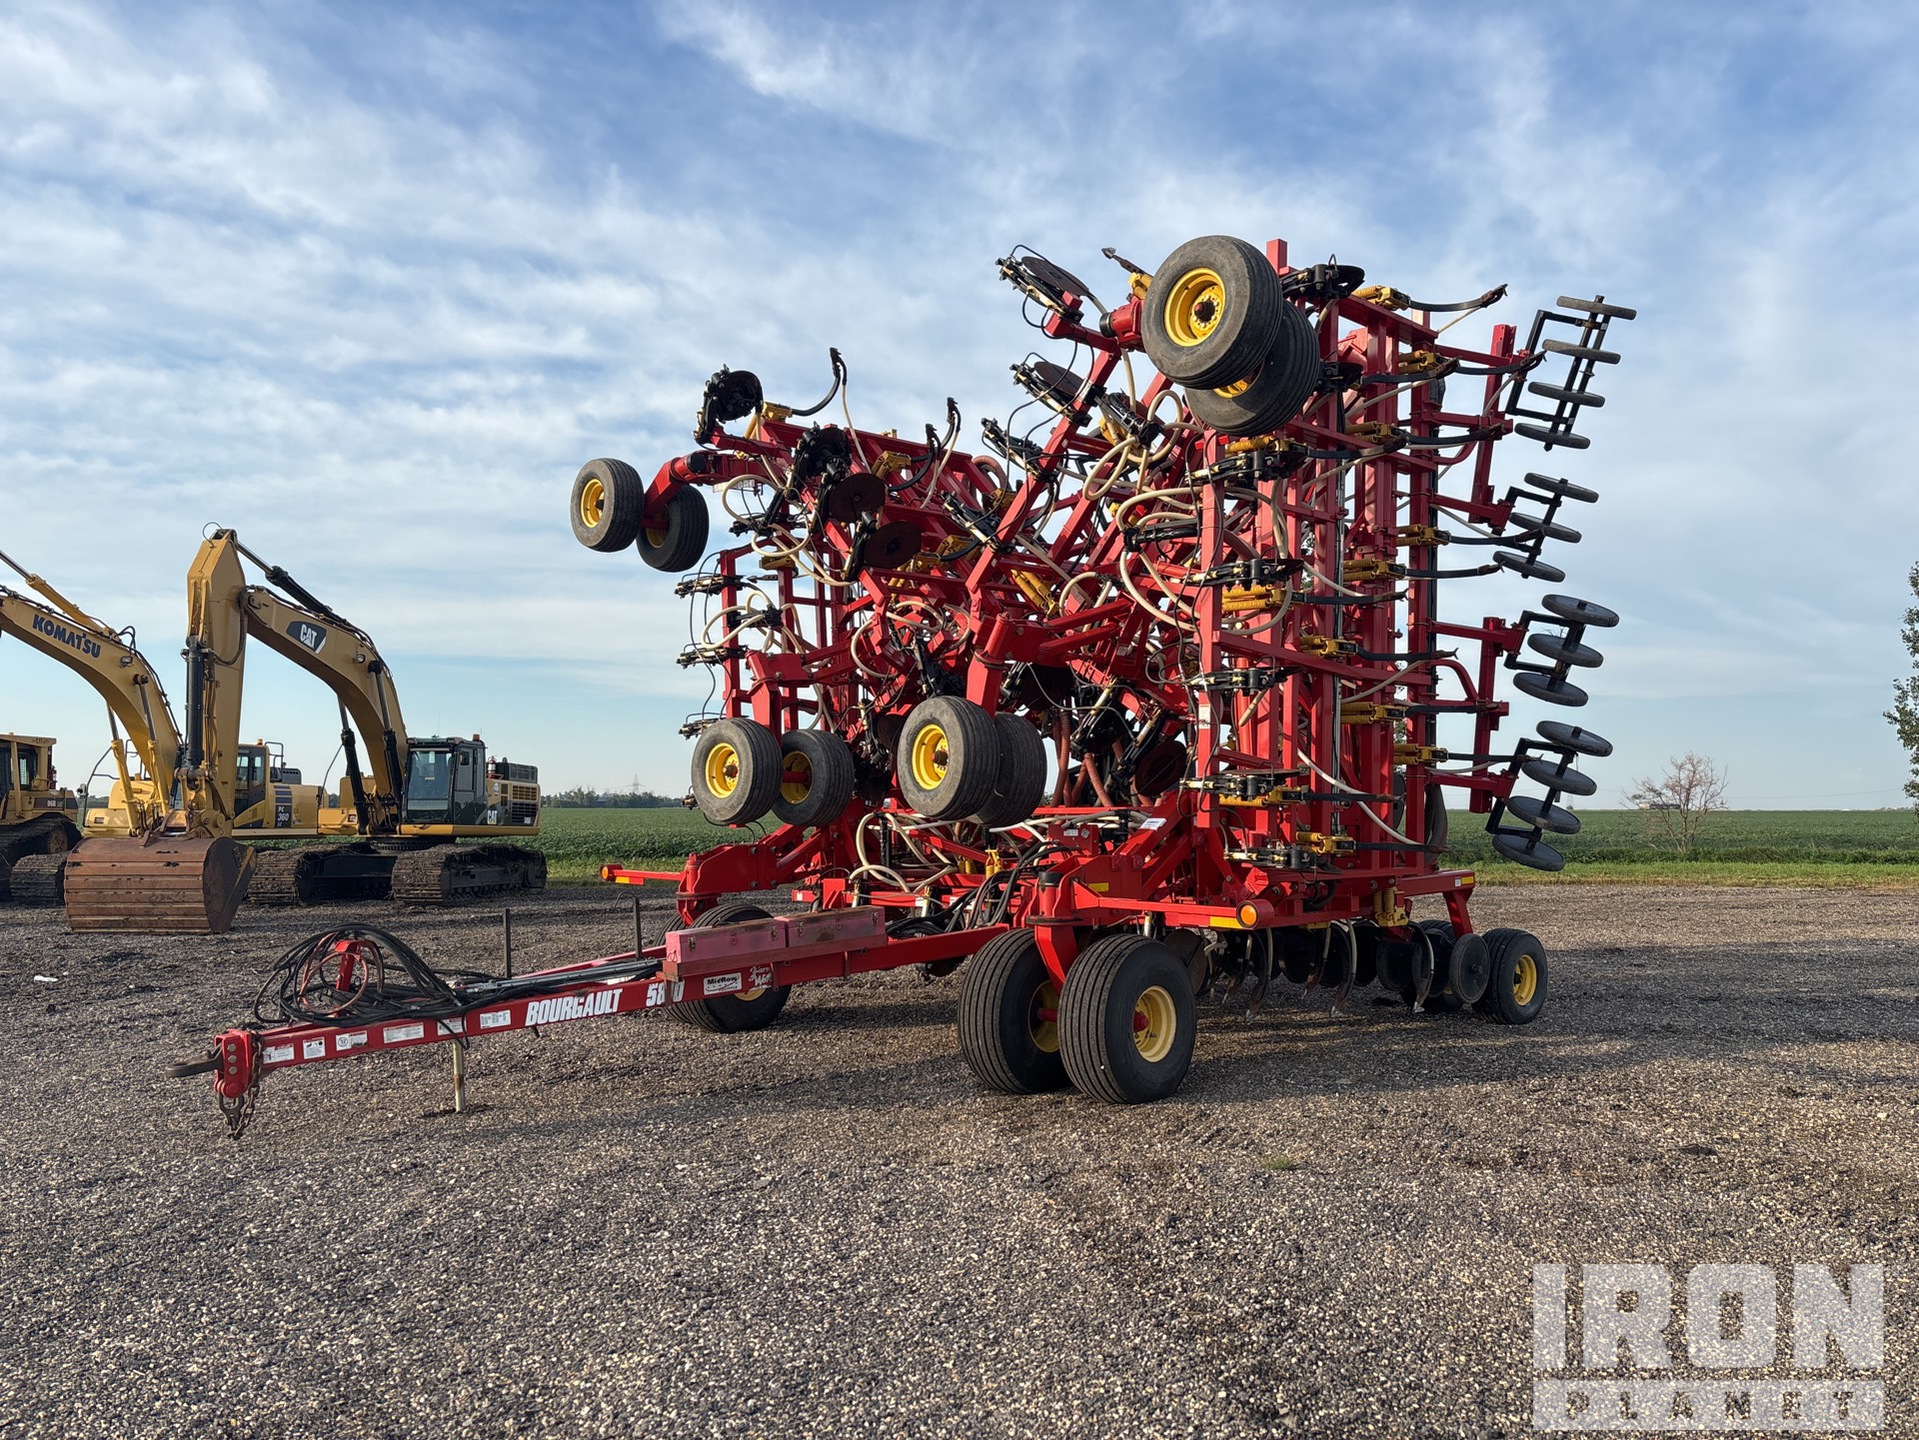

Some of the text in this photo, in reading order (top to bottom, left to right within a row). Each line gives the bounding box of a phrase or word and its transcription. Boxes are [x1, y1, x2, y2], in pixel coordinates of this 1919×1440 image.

[33, 614, 101, 658] KOMATSU
[300, 624, 317, 649] CAT
[487, 810, 498, 825] CAT
[525, 988, 624, 1027] BOURGAULT
[646, 979, 686, 1007] 580
